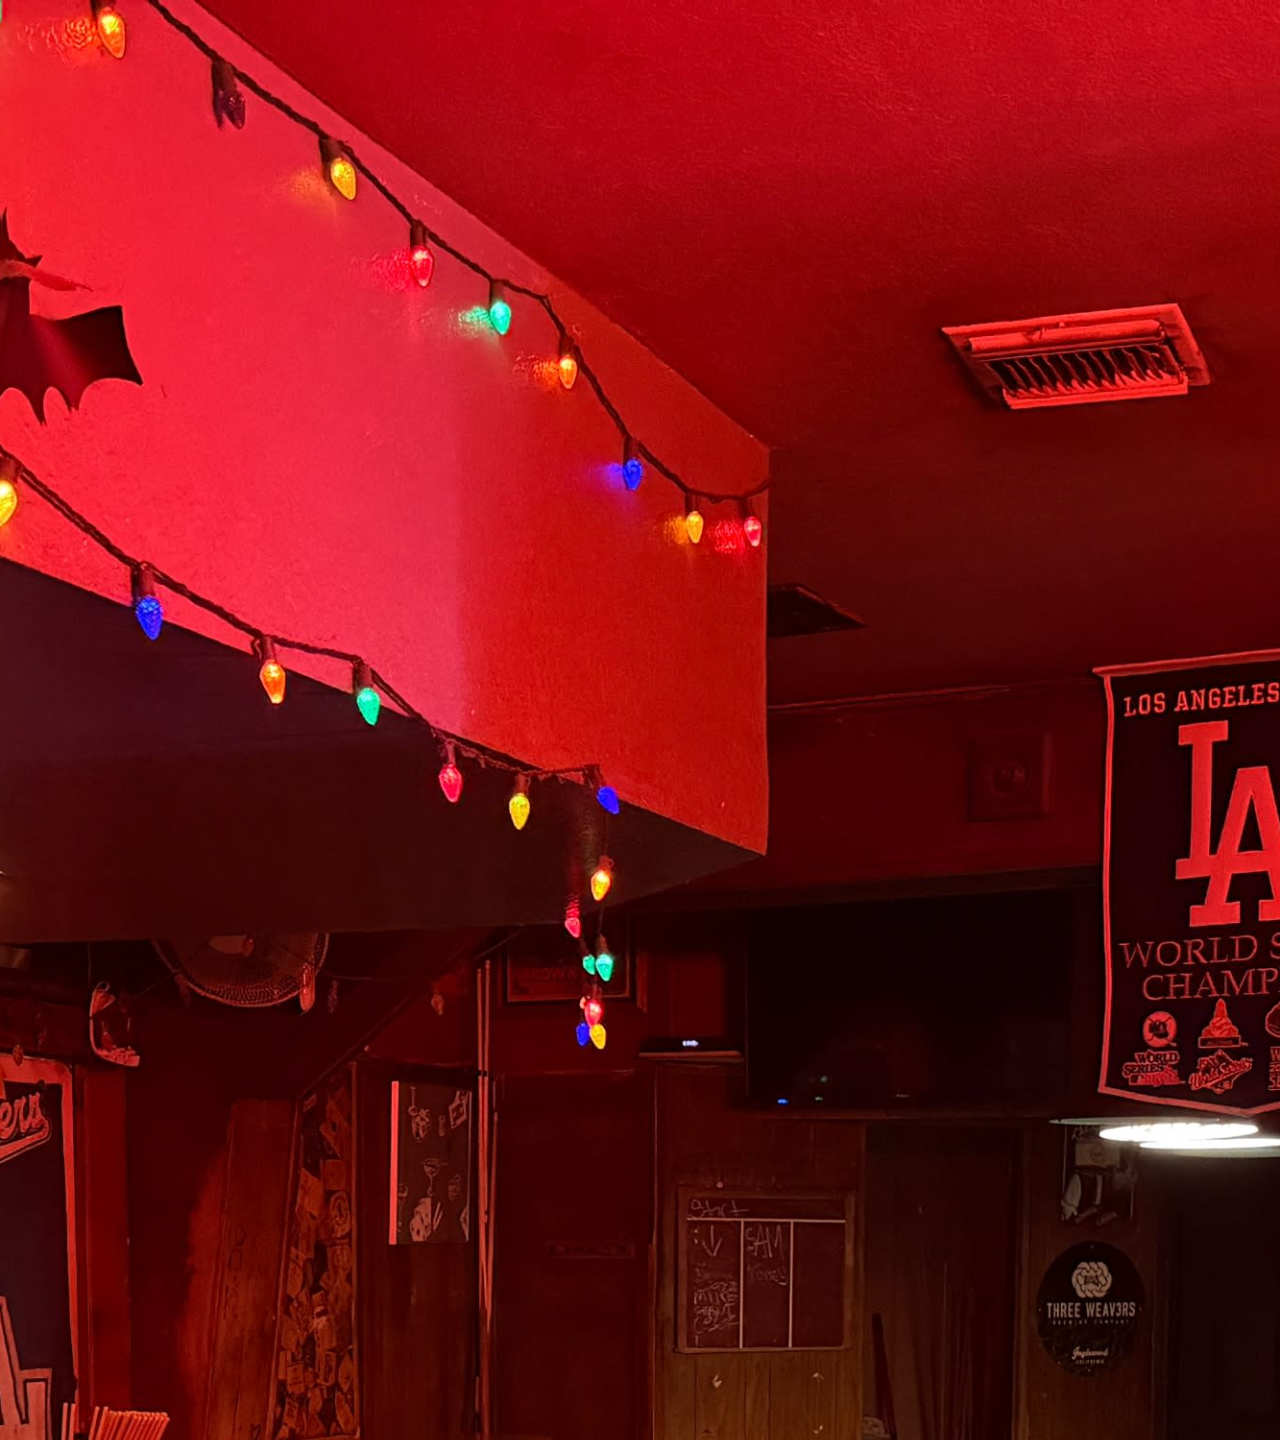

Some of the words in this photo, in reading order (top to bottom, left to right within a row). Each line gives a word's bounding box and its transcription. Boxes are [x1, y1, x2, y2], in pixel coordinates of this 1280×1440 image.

[1123, 692, 1166, 717] LOS
[1173, 682, 1280, 712] ANGELES
[1119, 935, 1258, 968] WORLD
[1047, 1302, 1081, 1318] THREE
